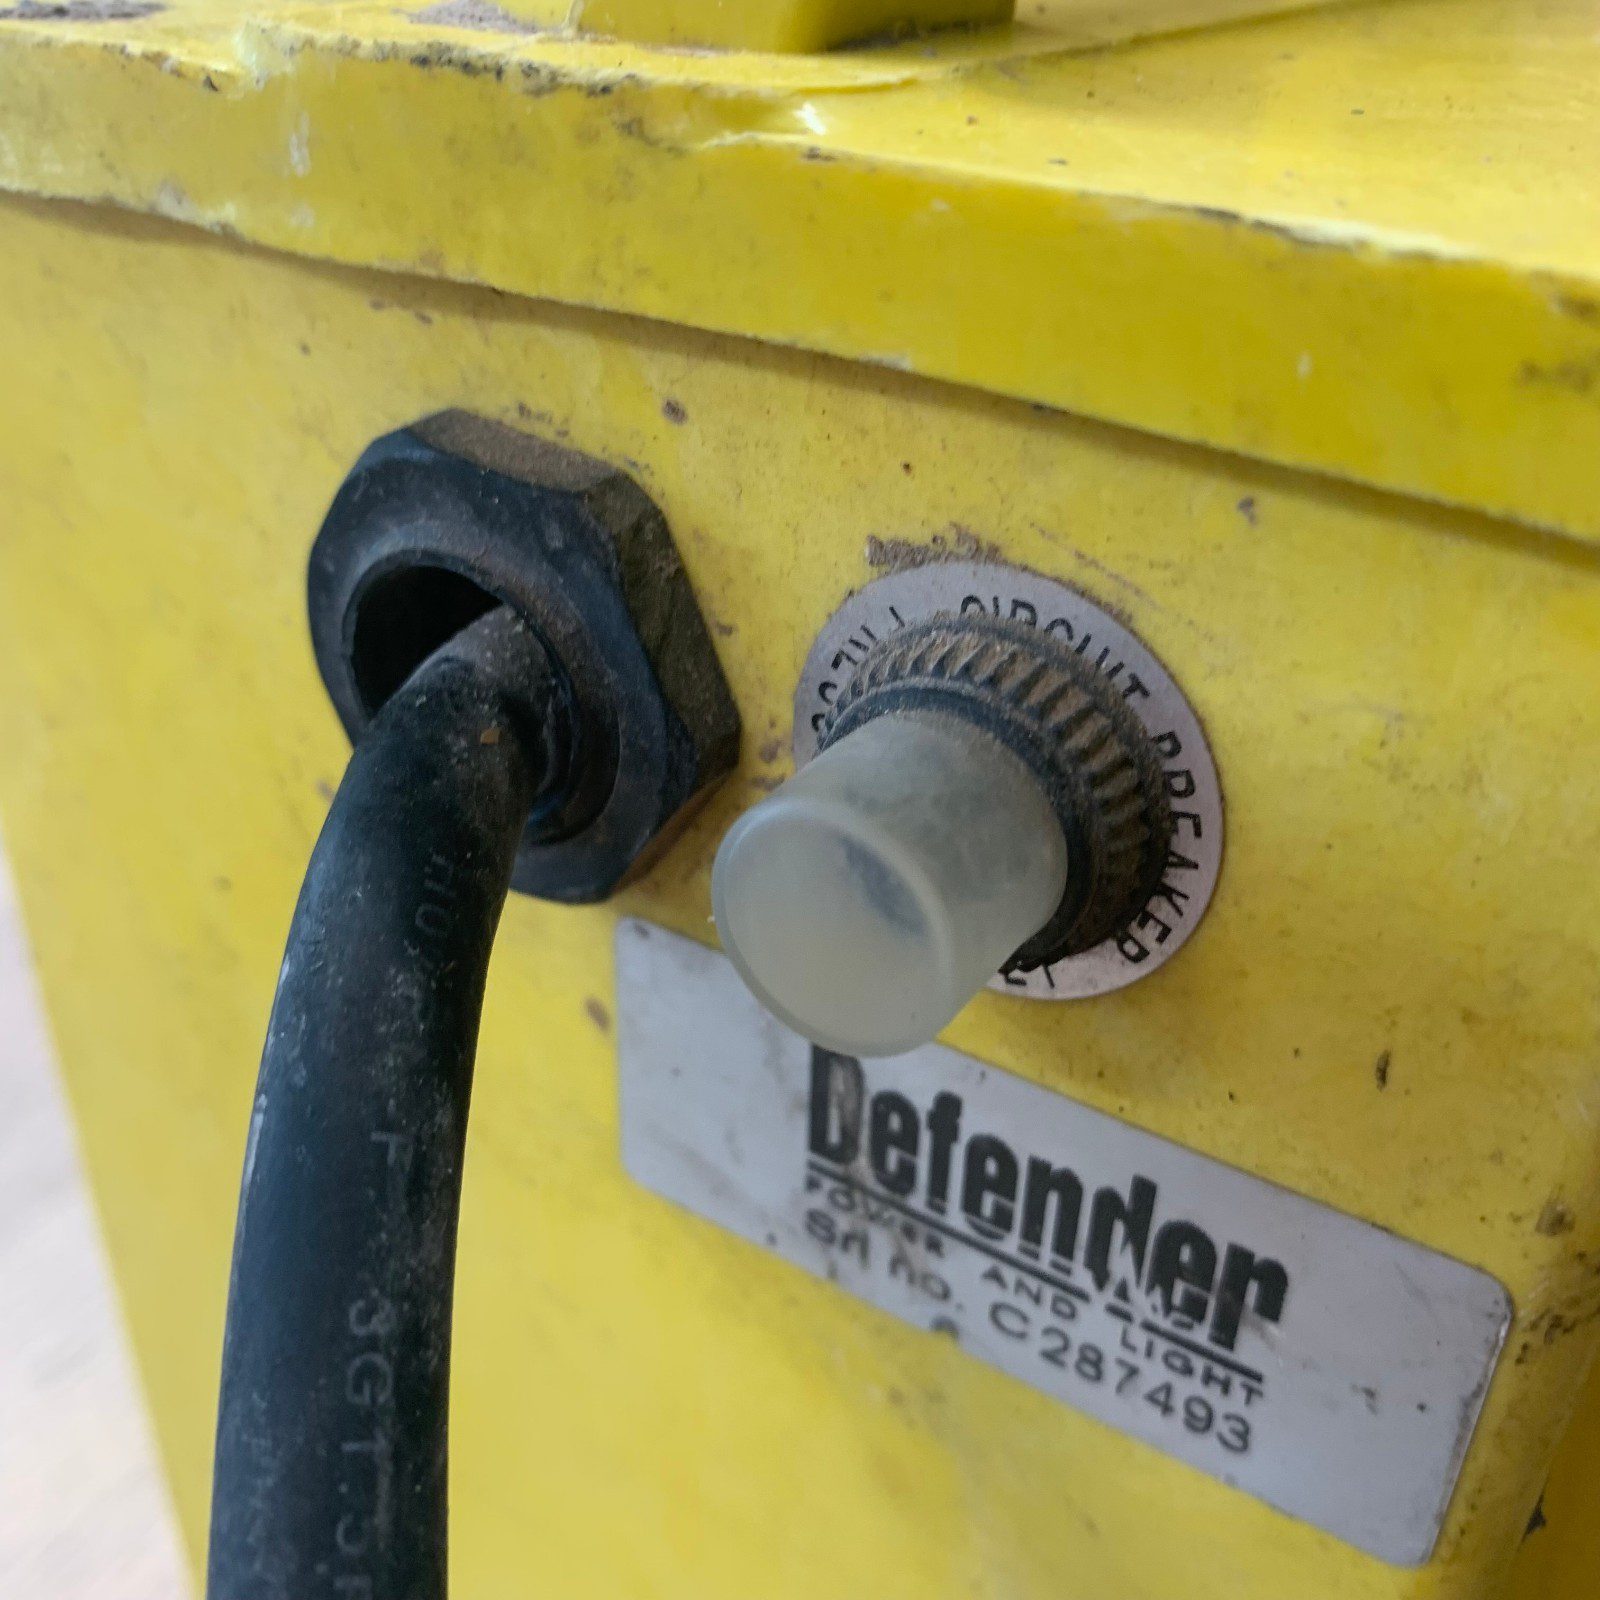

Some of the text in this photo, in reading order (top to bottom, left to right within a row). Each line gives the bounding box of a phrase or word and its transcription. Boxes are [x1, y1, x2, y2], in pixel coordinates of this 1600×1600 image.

[809, 1044, 1289, 1352] Defender
[980, 1265, 1078, 1322] AND
[1120, 1324, 1265, 1406] LIGHT
[988, 1301, 1251, 1455] C287493
